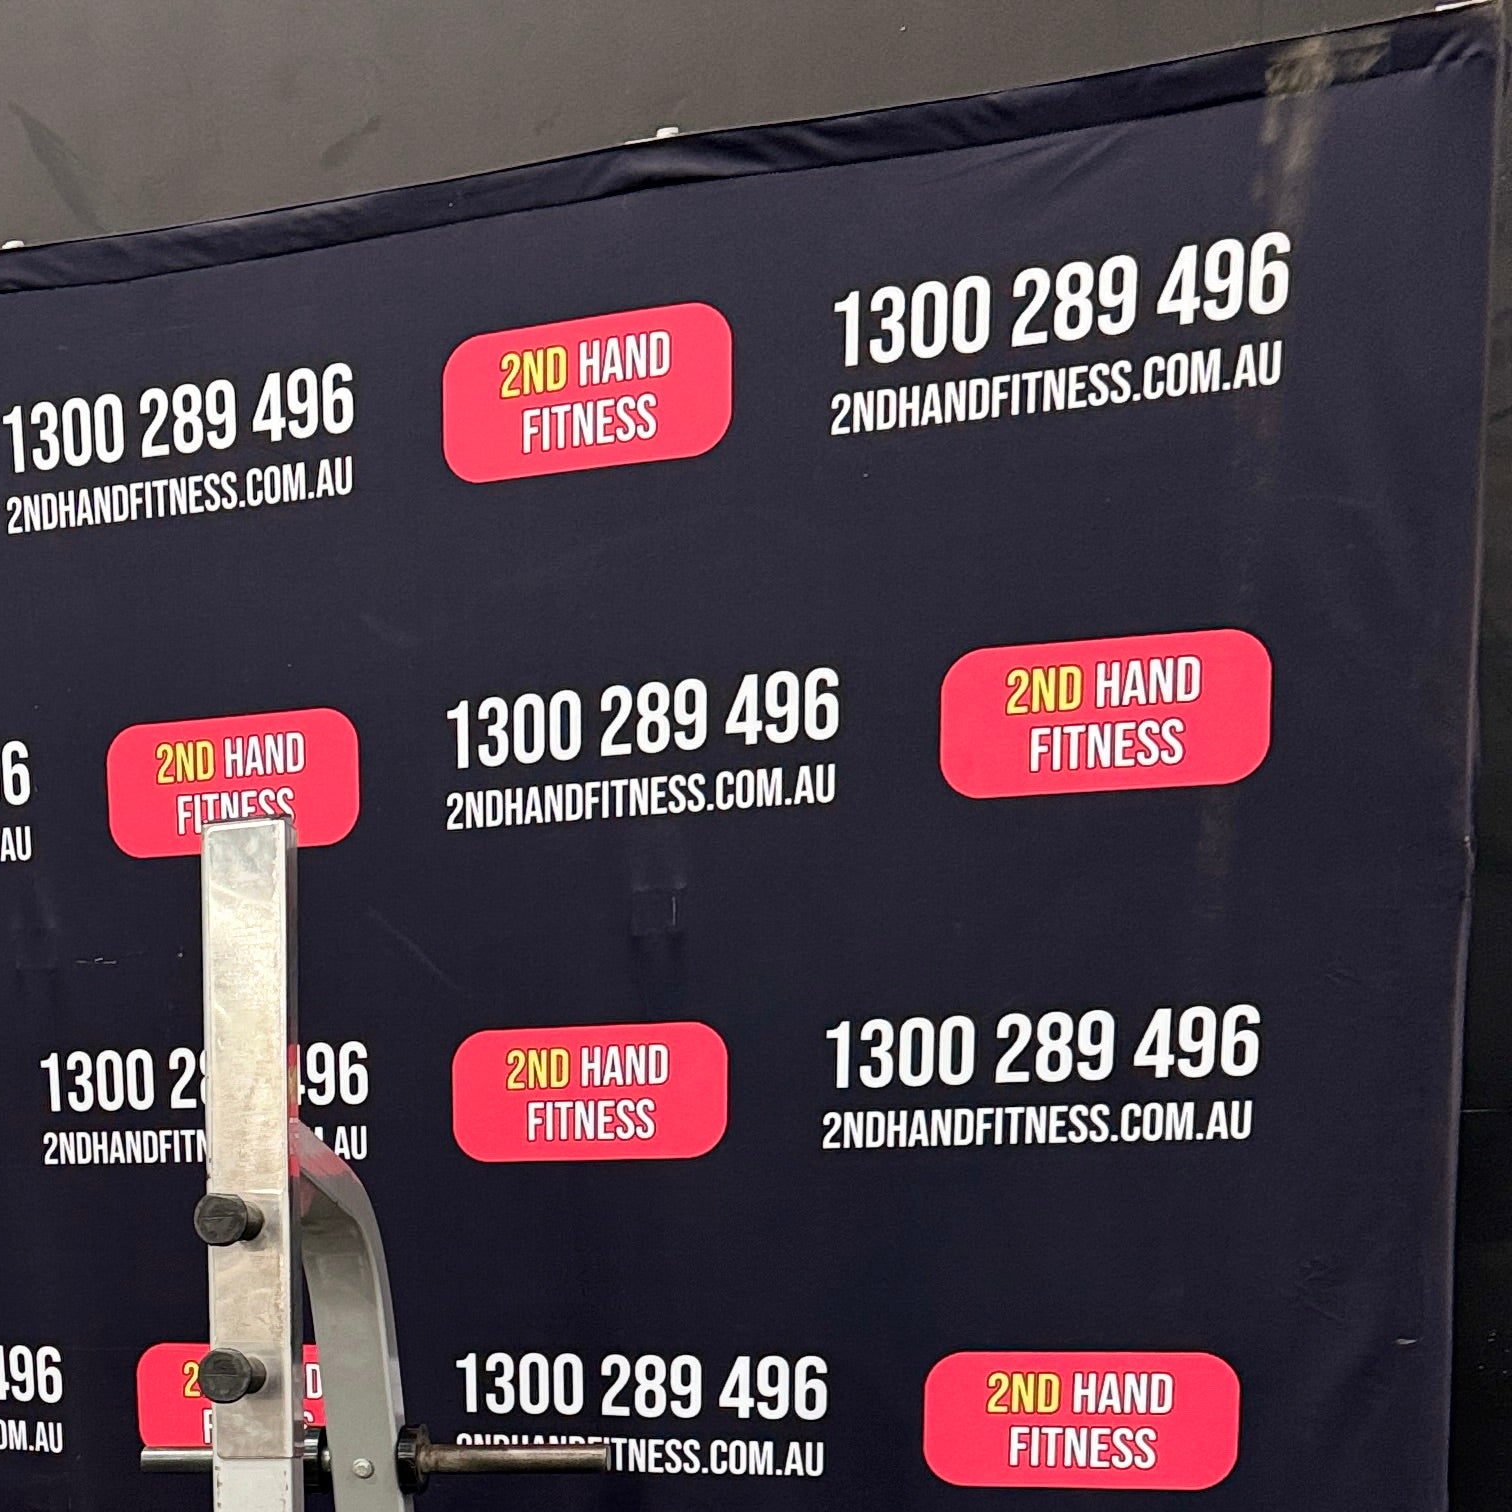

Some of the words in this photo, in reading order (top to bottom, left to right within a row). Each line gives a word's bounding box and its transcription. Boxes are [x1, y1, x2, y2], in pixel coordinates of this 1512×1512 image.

[833, 275, 991, 367] 1300
[1011, 254, 1138, 348] 289
[1156, 231, 1291, 326] 496
[501, 346, 567, 398] 2ND
[579, 331, 671, 387] HAND
[830, 340, 1283, 436] 2NDHANDFITNESS.COM.AU
[2, 393, 125, 474] 1300
[139, 379, 237, 459] 289
[252, 362, 354, 442] 496
[523, 393, 657, 454] FITNESS
[6, 455, 353, 535] 2NDHANDFITNESS.COM.AU
[446, 689, 582, 769] 1300
[600, 678, 708, 757] 289
[724, 667, 839, 746] 496
[1006, 665, 1082, 715] 2ND
[1096, 656, 1201, 708] HAND
[156, 740, 215, 784] 2ND
[224, 732, 305, 778] HAND
[1030, 718, 1184, 772] FITNESS
[446, 763, 836, 831] 2NDHANDFITNESS.COM.AU
[40, 1048, 155, 1112] 1300
[297, 1041, 369, 1106] 96
[507, 1048, 569, 1090] 2ND
[581, 1044, 669, 1087] HAND
[826, 1015, 976, 1089] 1300
[994, 1009, 1115, 1084] 289
[1133, 1003, 1261, 1079] 496
[527, 1098, 655, 1141] FITNESS
[822, 1100, 1253, 1150] 2NDHANDFITNESS.COM.AU
[455, 1352, 584, 1416] 1300
[600, 1353, 702, 1419] 289
[718, 1355, 828, 1421] 496
[987, 1372, 1060, 1413] 2ND
[1073, 1372, 1173, 1414] HAND
[1009, 1426, 1157, 1469] FITNESS
